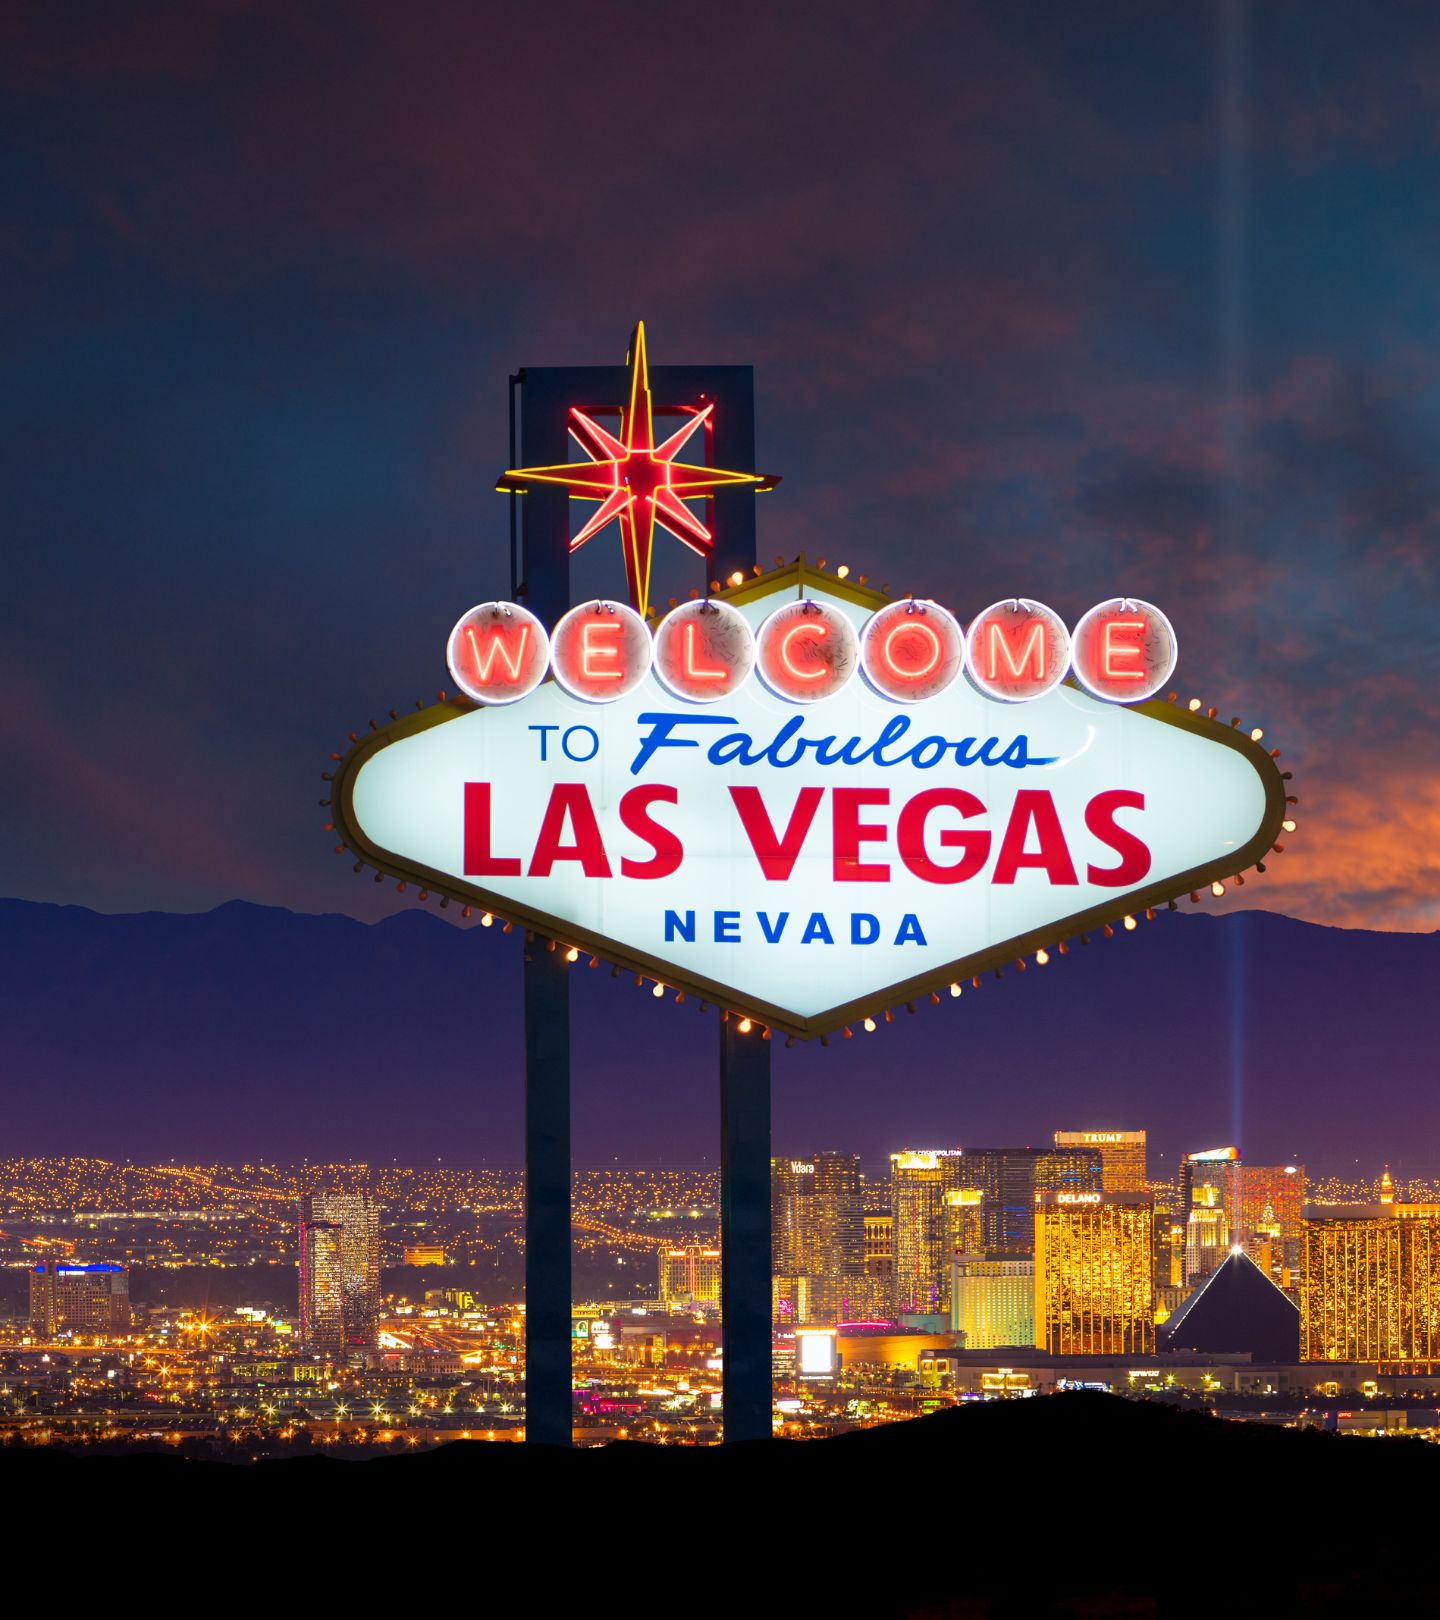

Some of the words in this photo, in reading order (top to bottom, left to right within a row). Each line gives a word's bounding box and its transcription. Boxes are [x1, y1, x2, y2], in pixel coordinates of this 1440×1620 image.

[466, 620, 1145, 682] WELCOME
[527, 725, 600, 763] TO
[629, 712, 1058, 776] Fabulous
[463, 782, 684, 880] LAS
[729, 786, 1151, 887] VEGAS
[664, 909, 928, 946] NEVADA
[1084, 1133, 1123, 1142] TRUMP
[790, 1161, 815, 1174] Vdara
[1057, 1194, 1101, 1203] DELANO
